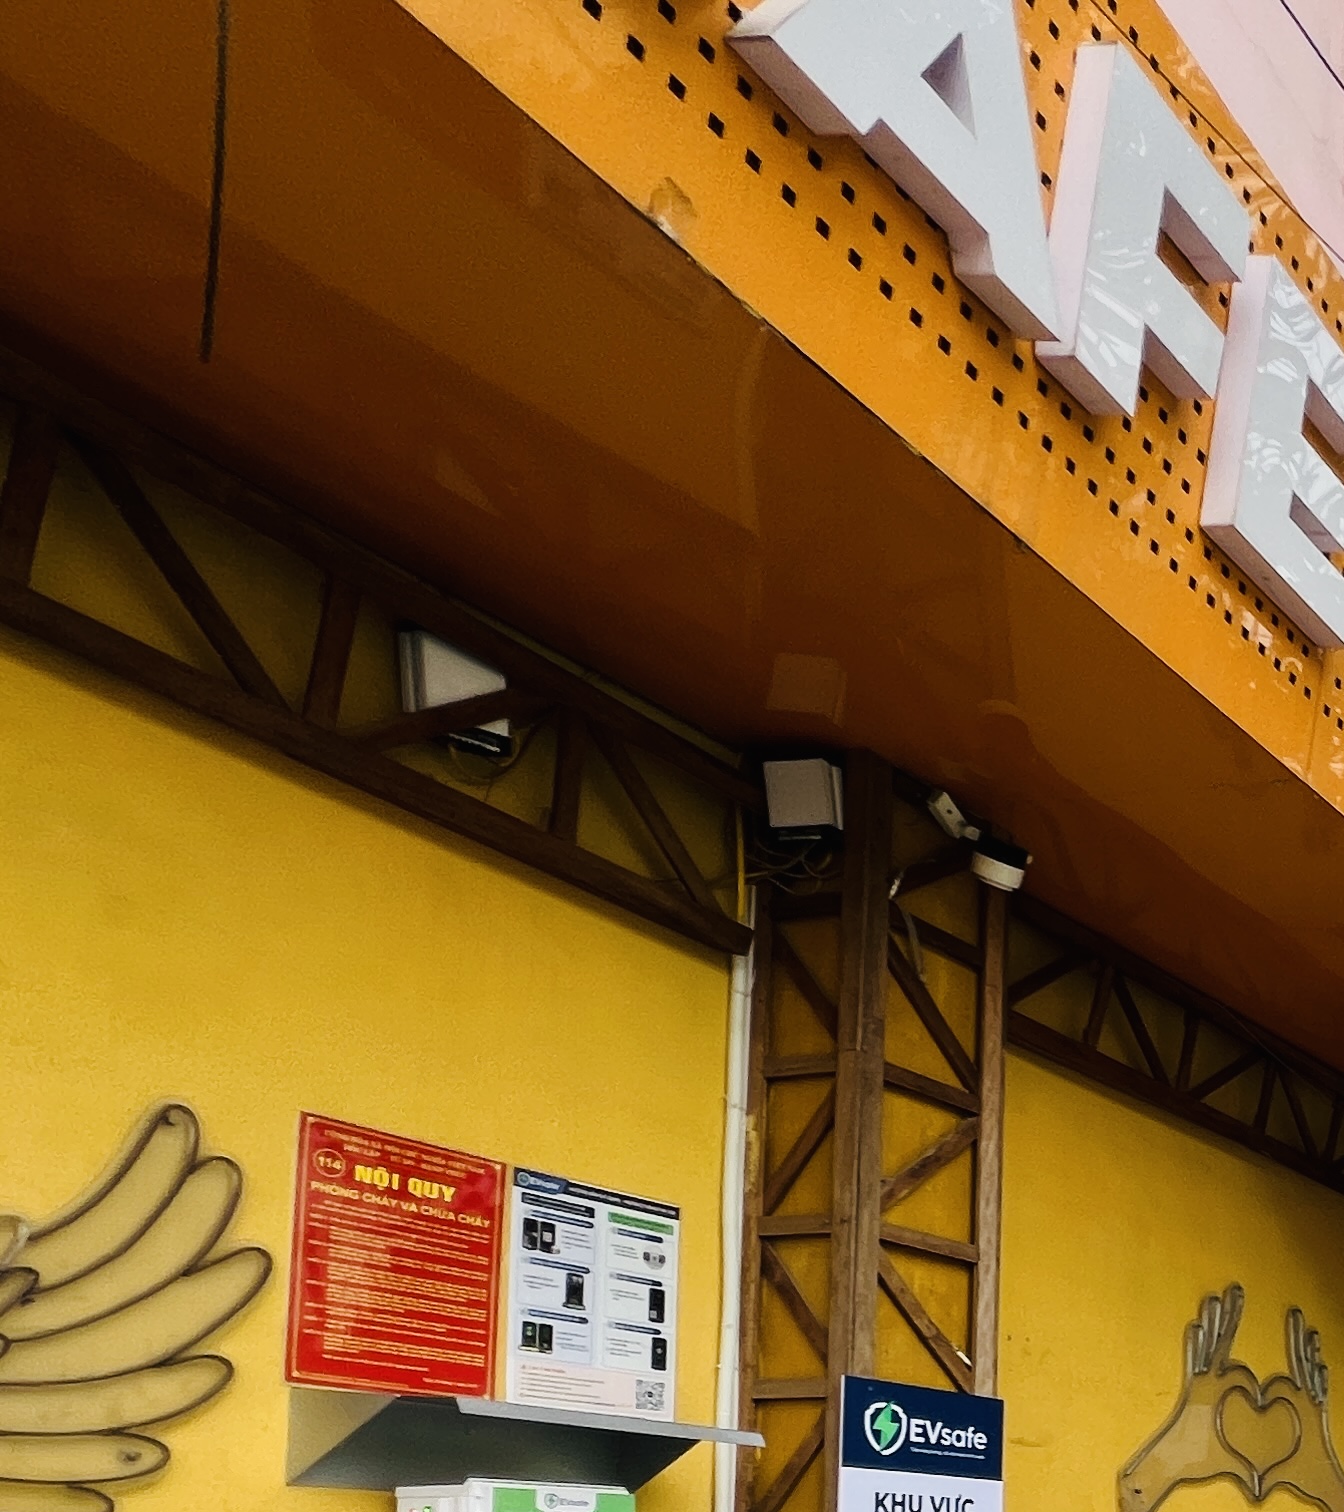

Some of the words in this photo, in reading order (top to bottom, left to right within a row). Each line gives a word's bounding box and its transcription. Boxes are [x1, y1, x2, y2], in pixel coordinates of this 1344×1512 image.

[317, 1155, 343, 1172] 114
[354, 1162, 400, 1191] NỘI
[407, 1177, 456, 1203] QUY
[909, 1418, 988, 1450] EVsafe
